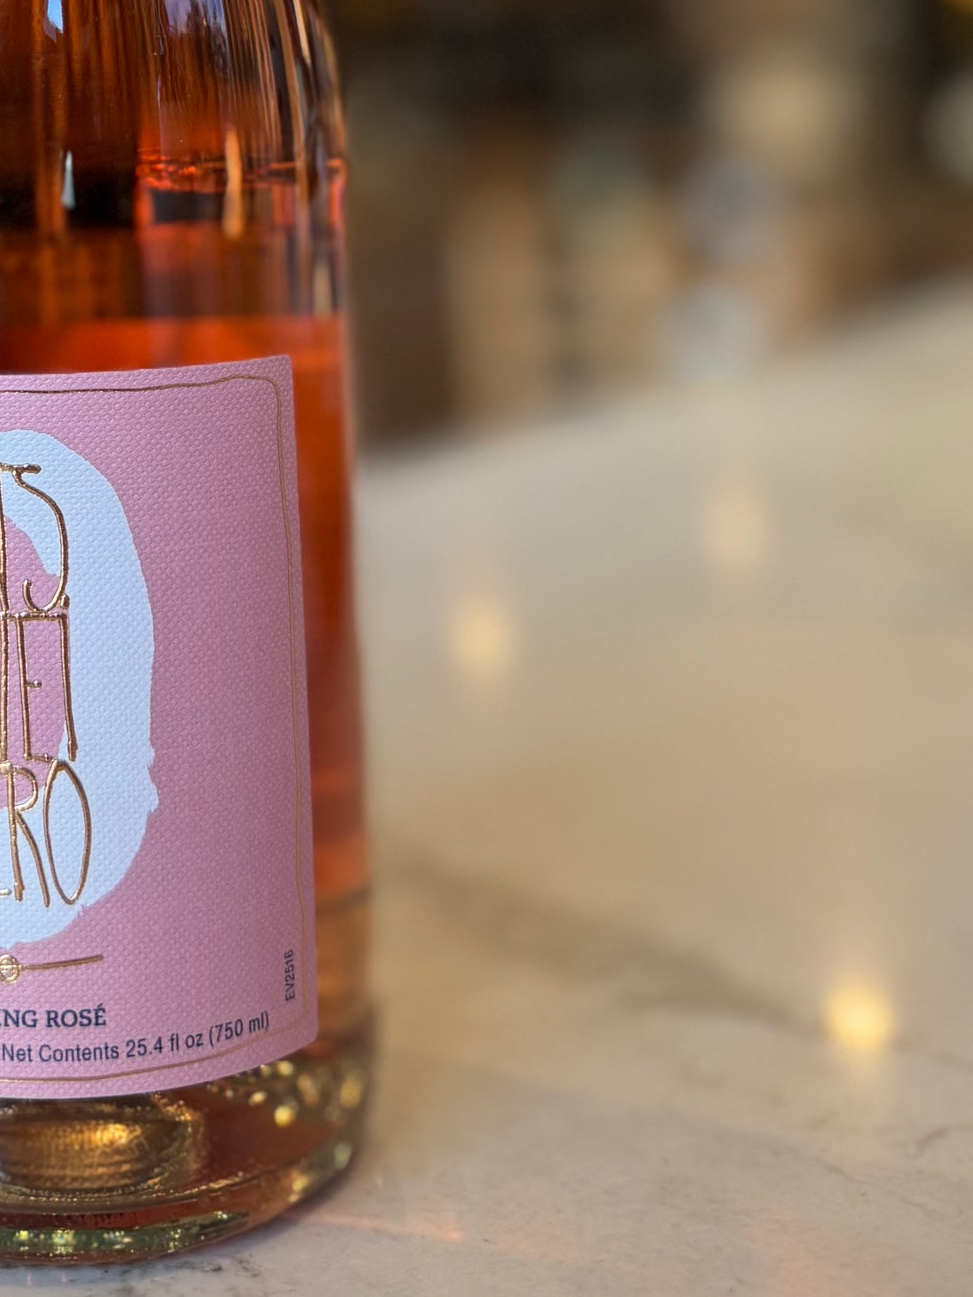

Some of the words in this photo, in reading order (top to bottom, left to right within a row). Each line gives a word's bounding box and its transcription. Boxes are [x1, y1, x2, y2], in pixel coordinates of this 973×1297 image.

[45, 1003, 107, 1028] ROSÉ
[1, 1044, 33, 1063] Net
[38, 1042, 119, 1064] Contents
[126, 1036, 164, 1059] 25.4
[170, 1033, 180, 1052] fl
[185, 1032, 204, 1049] oz
[209, 1018, 244, 1048] (750
[248, 1010, 270, 1034] ml)
